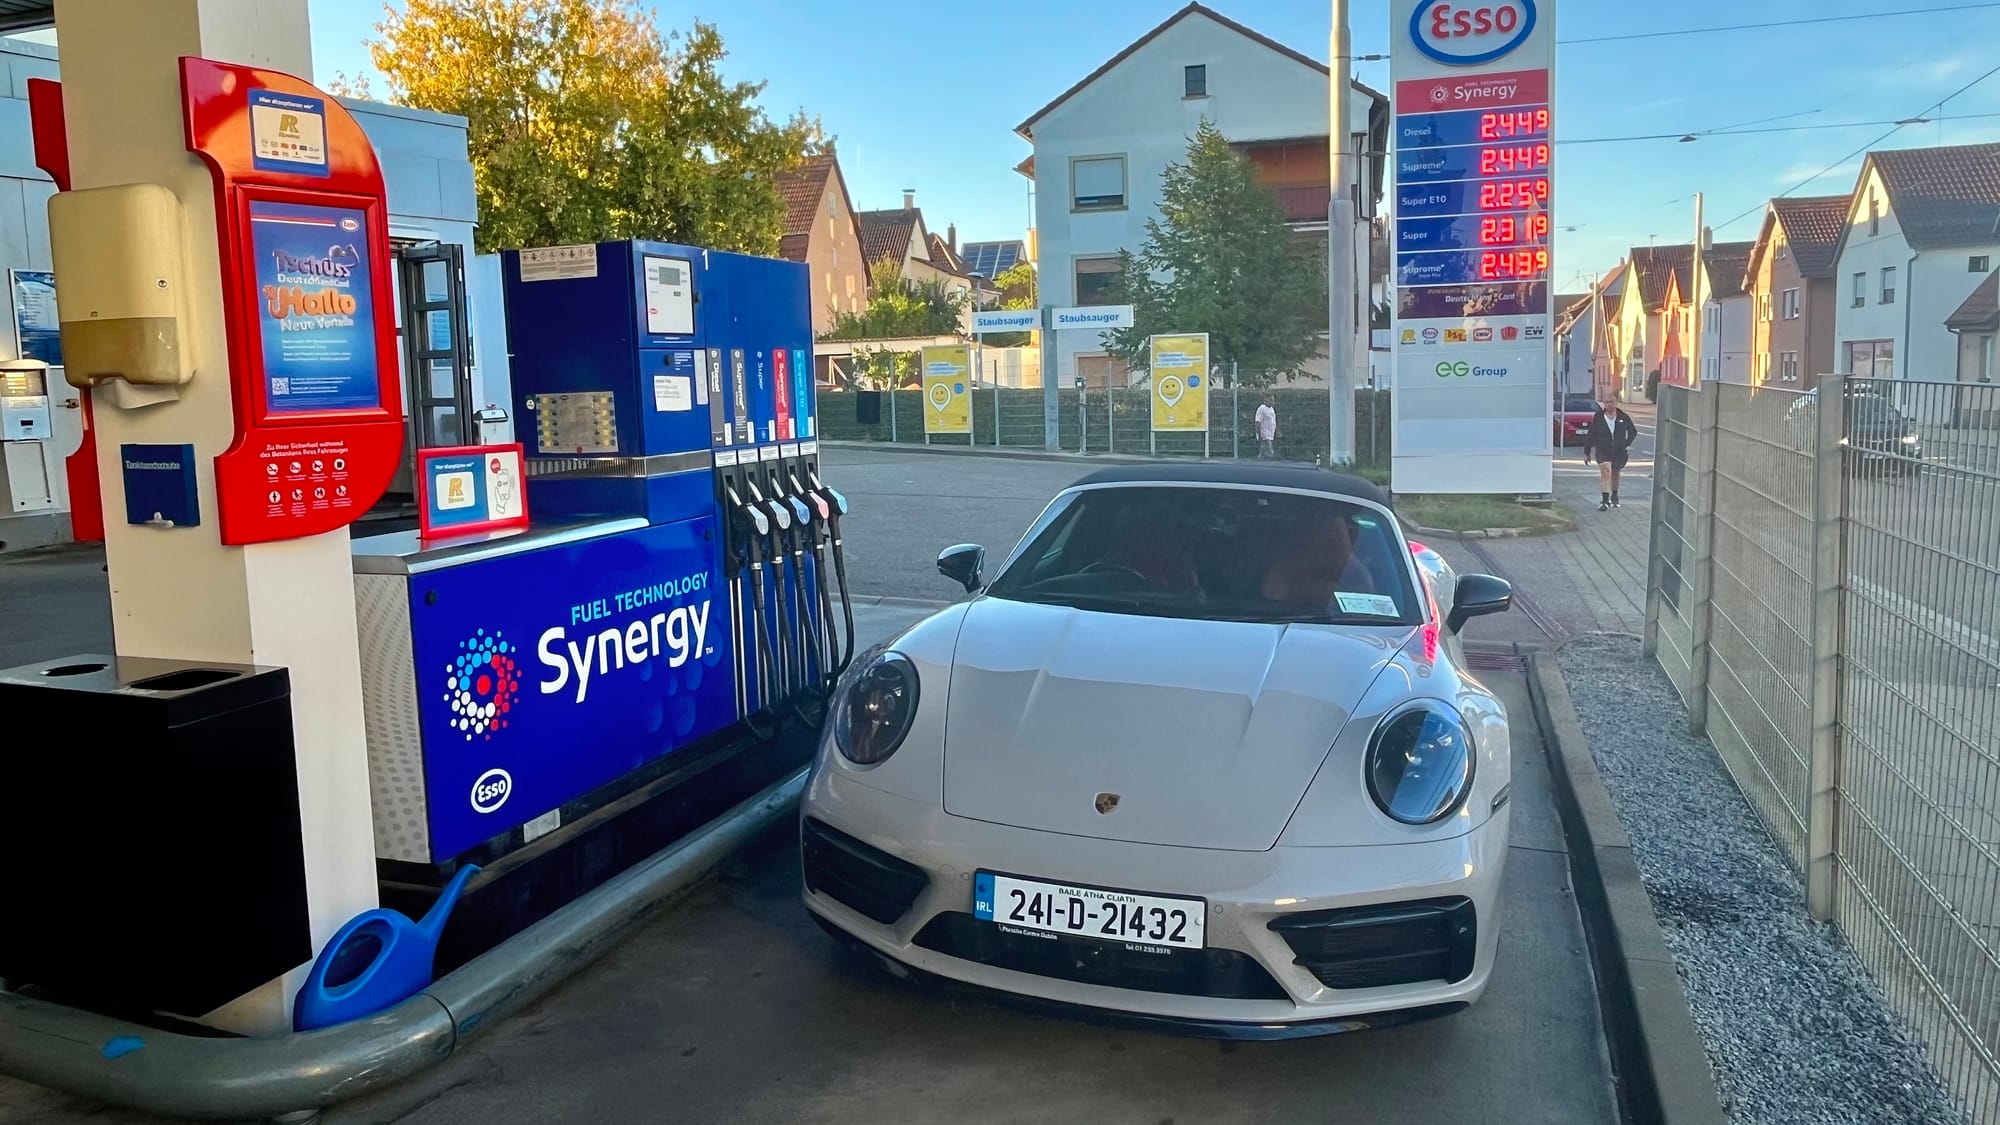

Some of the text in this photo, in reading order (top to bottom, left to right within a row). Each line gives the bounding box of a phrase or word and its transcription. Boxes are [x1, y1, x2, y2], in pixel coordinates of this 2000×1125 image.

[1431, 4, 1518, 39] Esso
[1454, 84, 1517, 102] Synergy
[1404, 110, 1548, 138] Diesel 2.449
[1481, 145, 1548, 173] 2.449
[1402, 180, 1548, 208] Super E10 2.259
[1402, 215, 1548, 243] Super 2.319
[702, 249, 709, 271] 1
[1481, 251, 1548, 278] 2.439
[263, 285, 356, 319] Hallo
[281, 319, 315, 332] Neue
[977, 316, 1034, 327] Staubsauger
[1059, 313, 1120, 323] Staubsauger
[1472, 366, 1507, 377] Group
[571, 571, 709, 626] FUEL TECHNOLOGY
[537, 600, 711, 704] Synergy
[477, 778, 507, 804] Esso
[1058, 888, 1081, 897] BAILE
[1107, 894, 1136, 904] CLIATH
[976, 889, 1187, 943] IRL 241-D-21432
